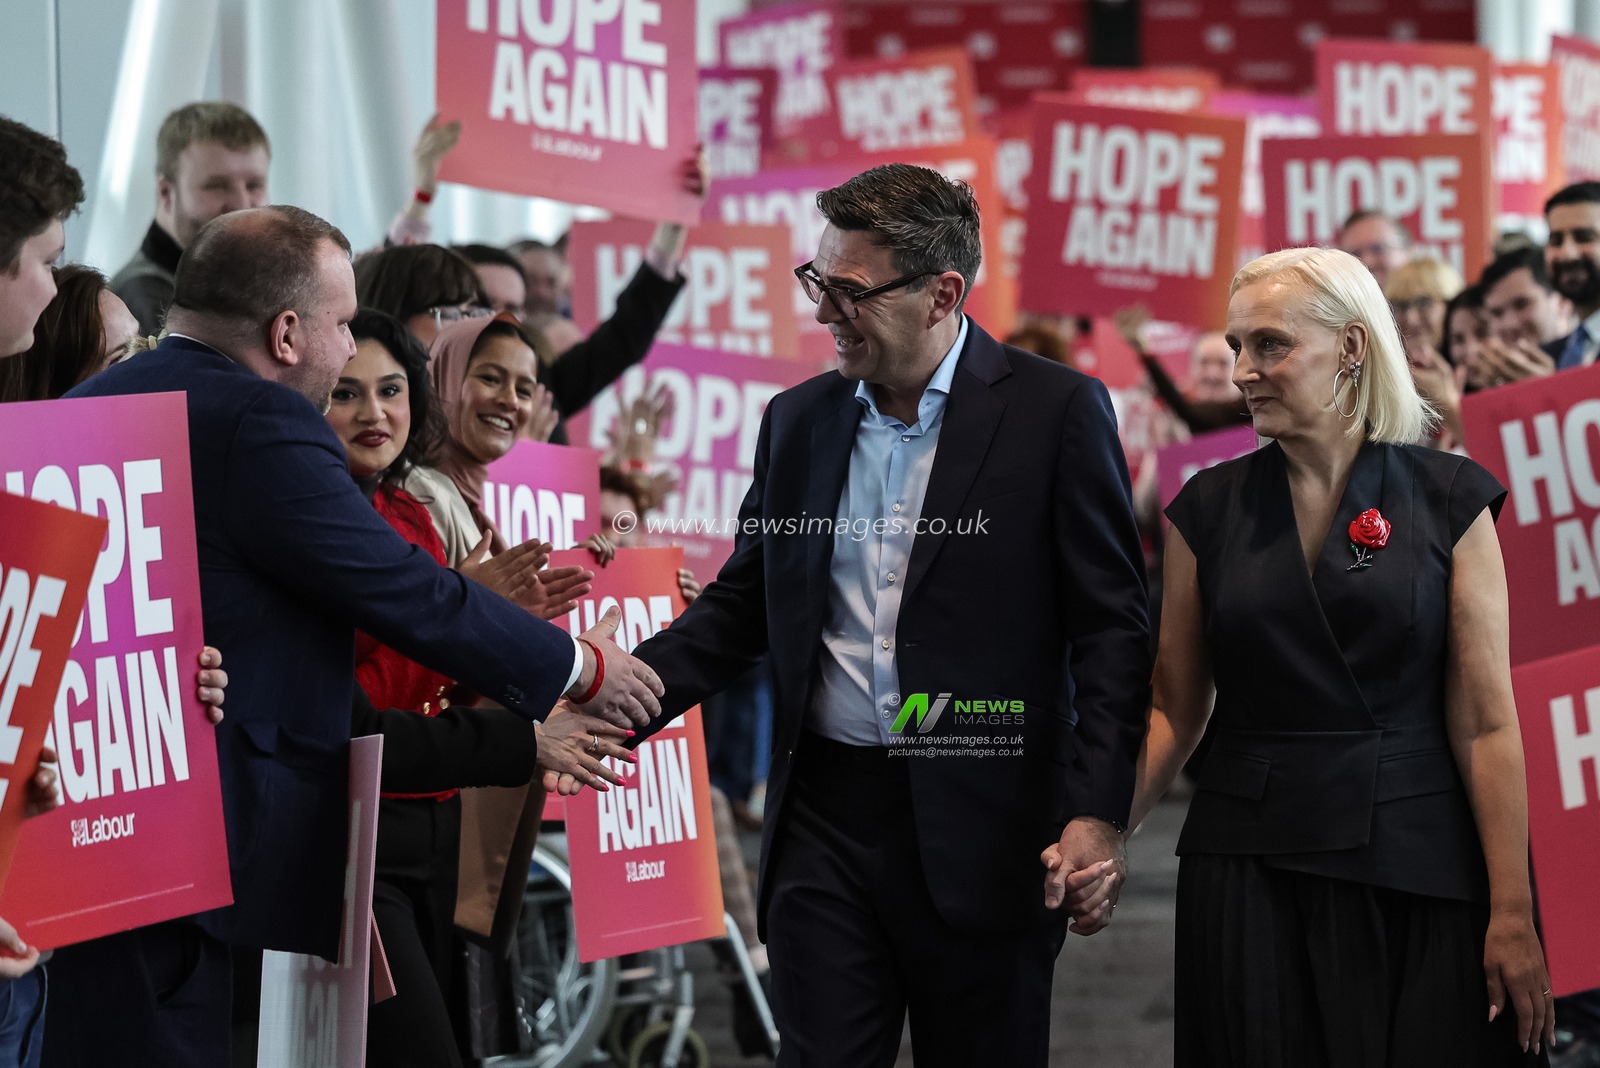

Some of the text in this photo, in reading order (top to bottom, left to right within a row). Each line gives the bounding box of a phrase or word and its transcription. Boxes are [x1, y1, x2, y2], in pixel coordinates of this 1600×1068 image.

[489, 41, 668, 150] AGAIN
[836, 65, 963, 138] HOPE
[1334, 61, 1478, 137] HOPE
[1050, 119, 1224, 216] HOPE
[1062, 203, 1217, 281] AGAIN
[596, 244, 774, 331] HPE
[84, 812, 136, 845] Labour
[598, 737, 699, 854] AGAIN
[632, 859, 666, 882] Labour
